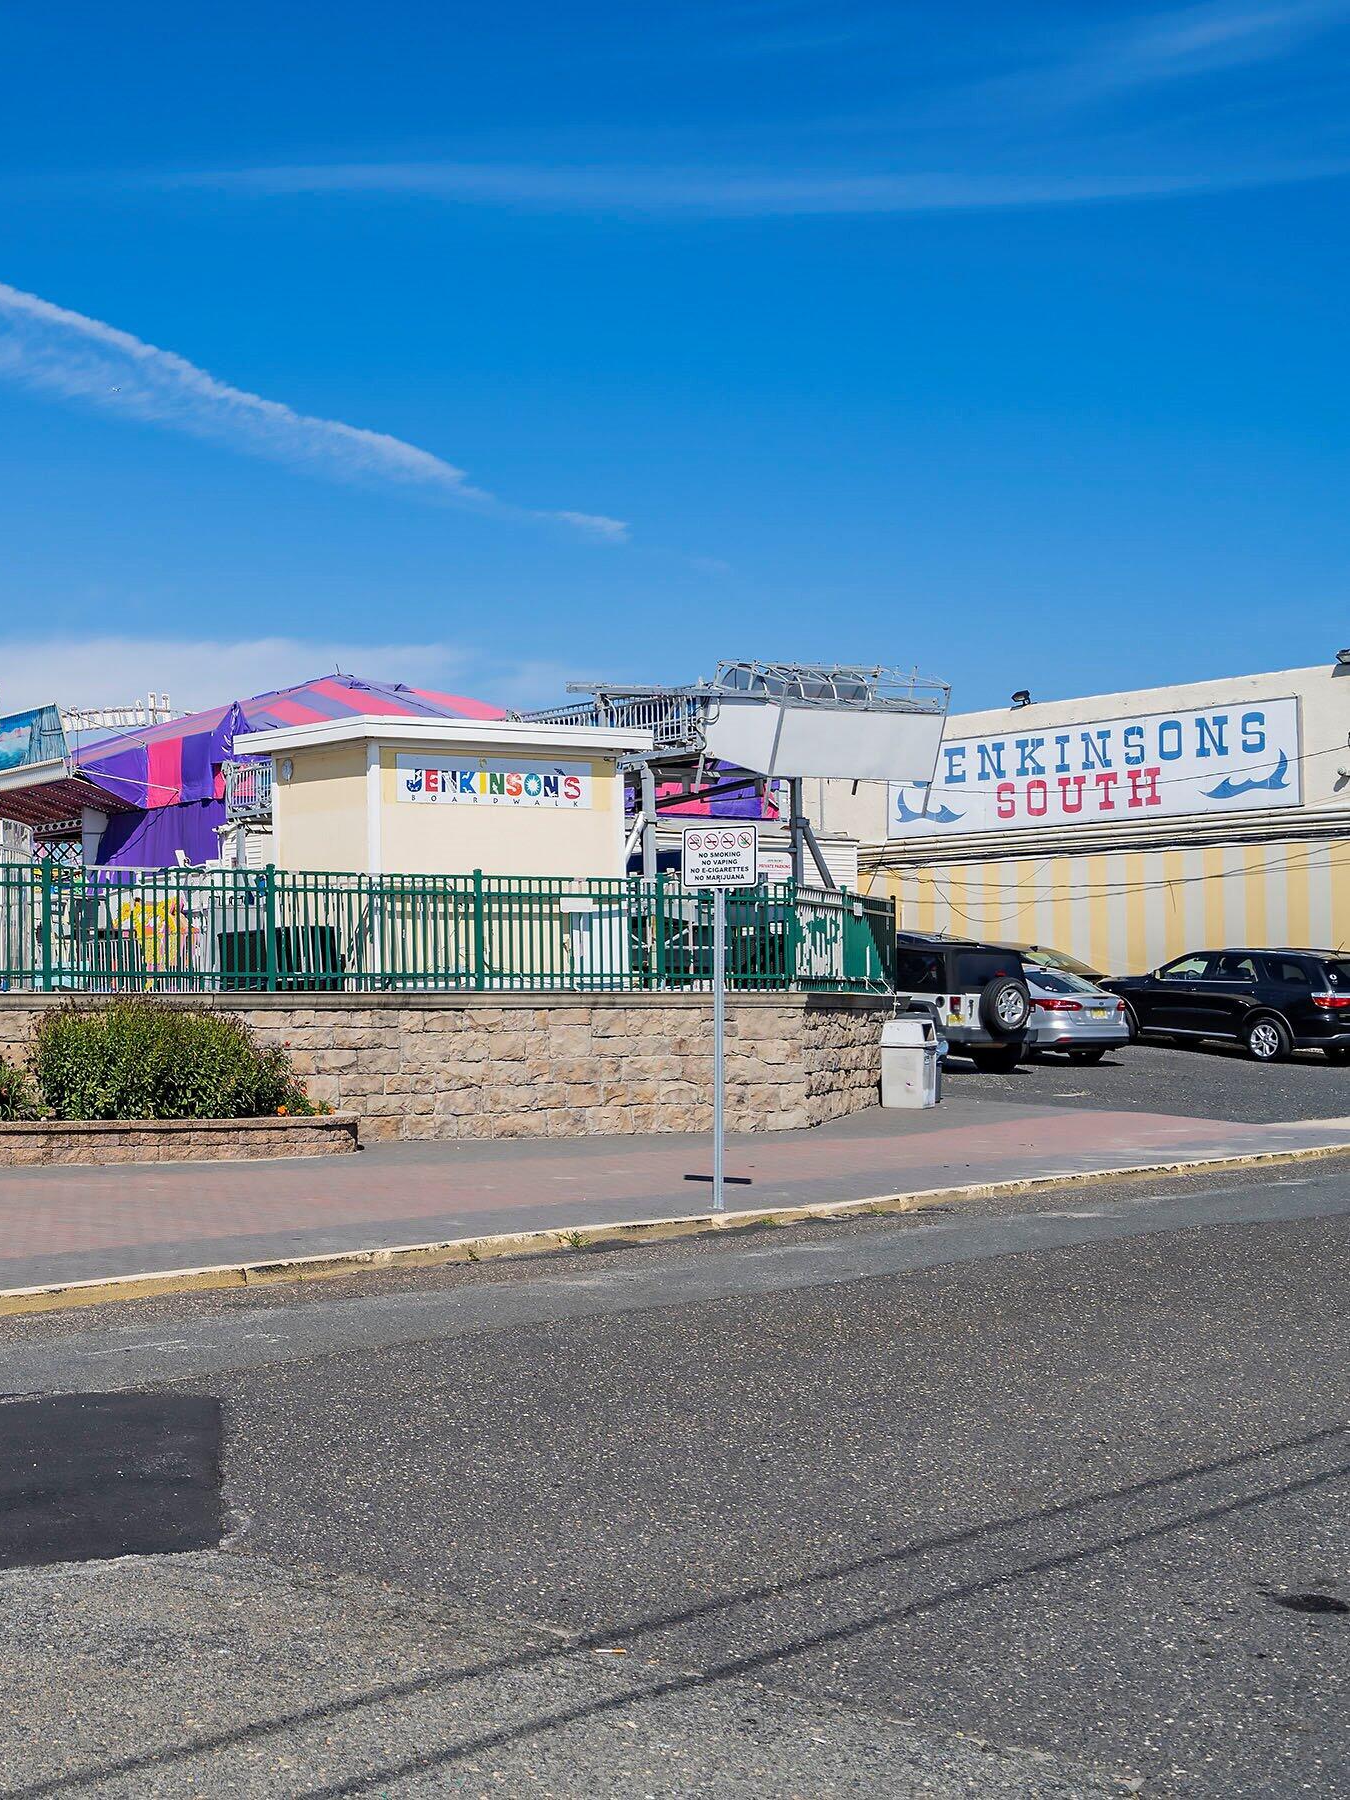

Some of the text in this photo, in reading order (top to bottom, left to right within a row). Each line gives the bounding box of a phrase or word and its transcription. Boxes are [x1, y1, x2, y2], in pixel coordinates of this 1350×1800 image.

[913, 711, 1266, 787] ENKINSONS
[411, 794, 578, 807] BOARDWALK
[997, 767, 1162, 819] SOUTH
